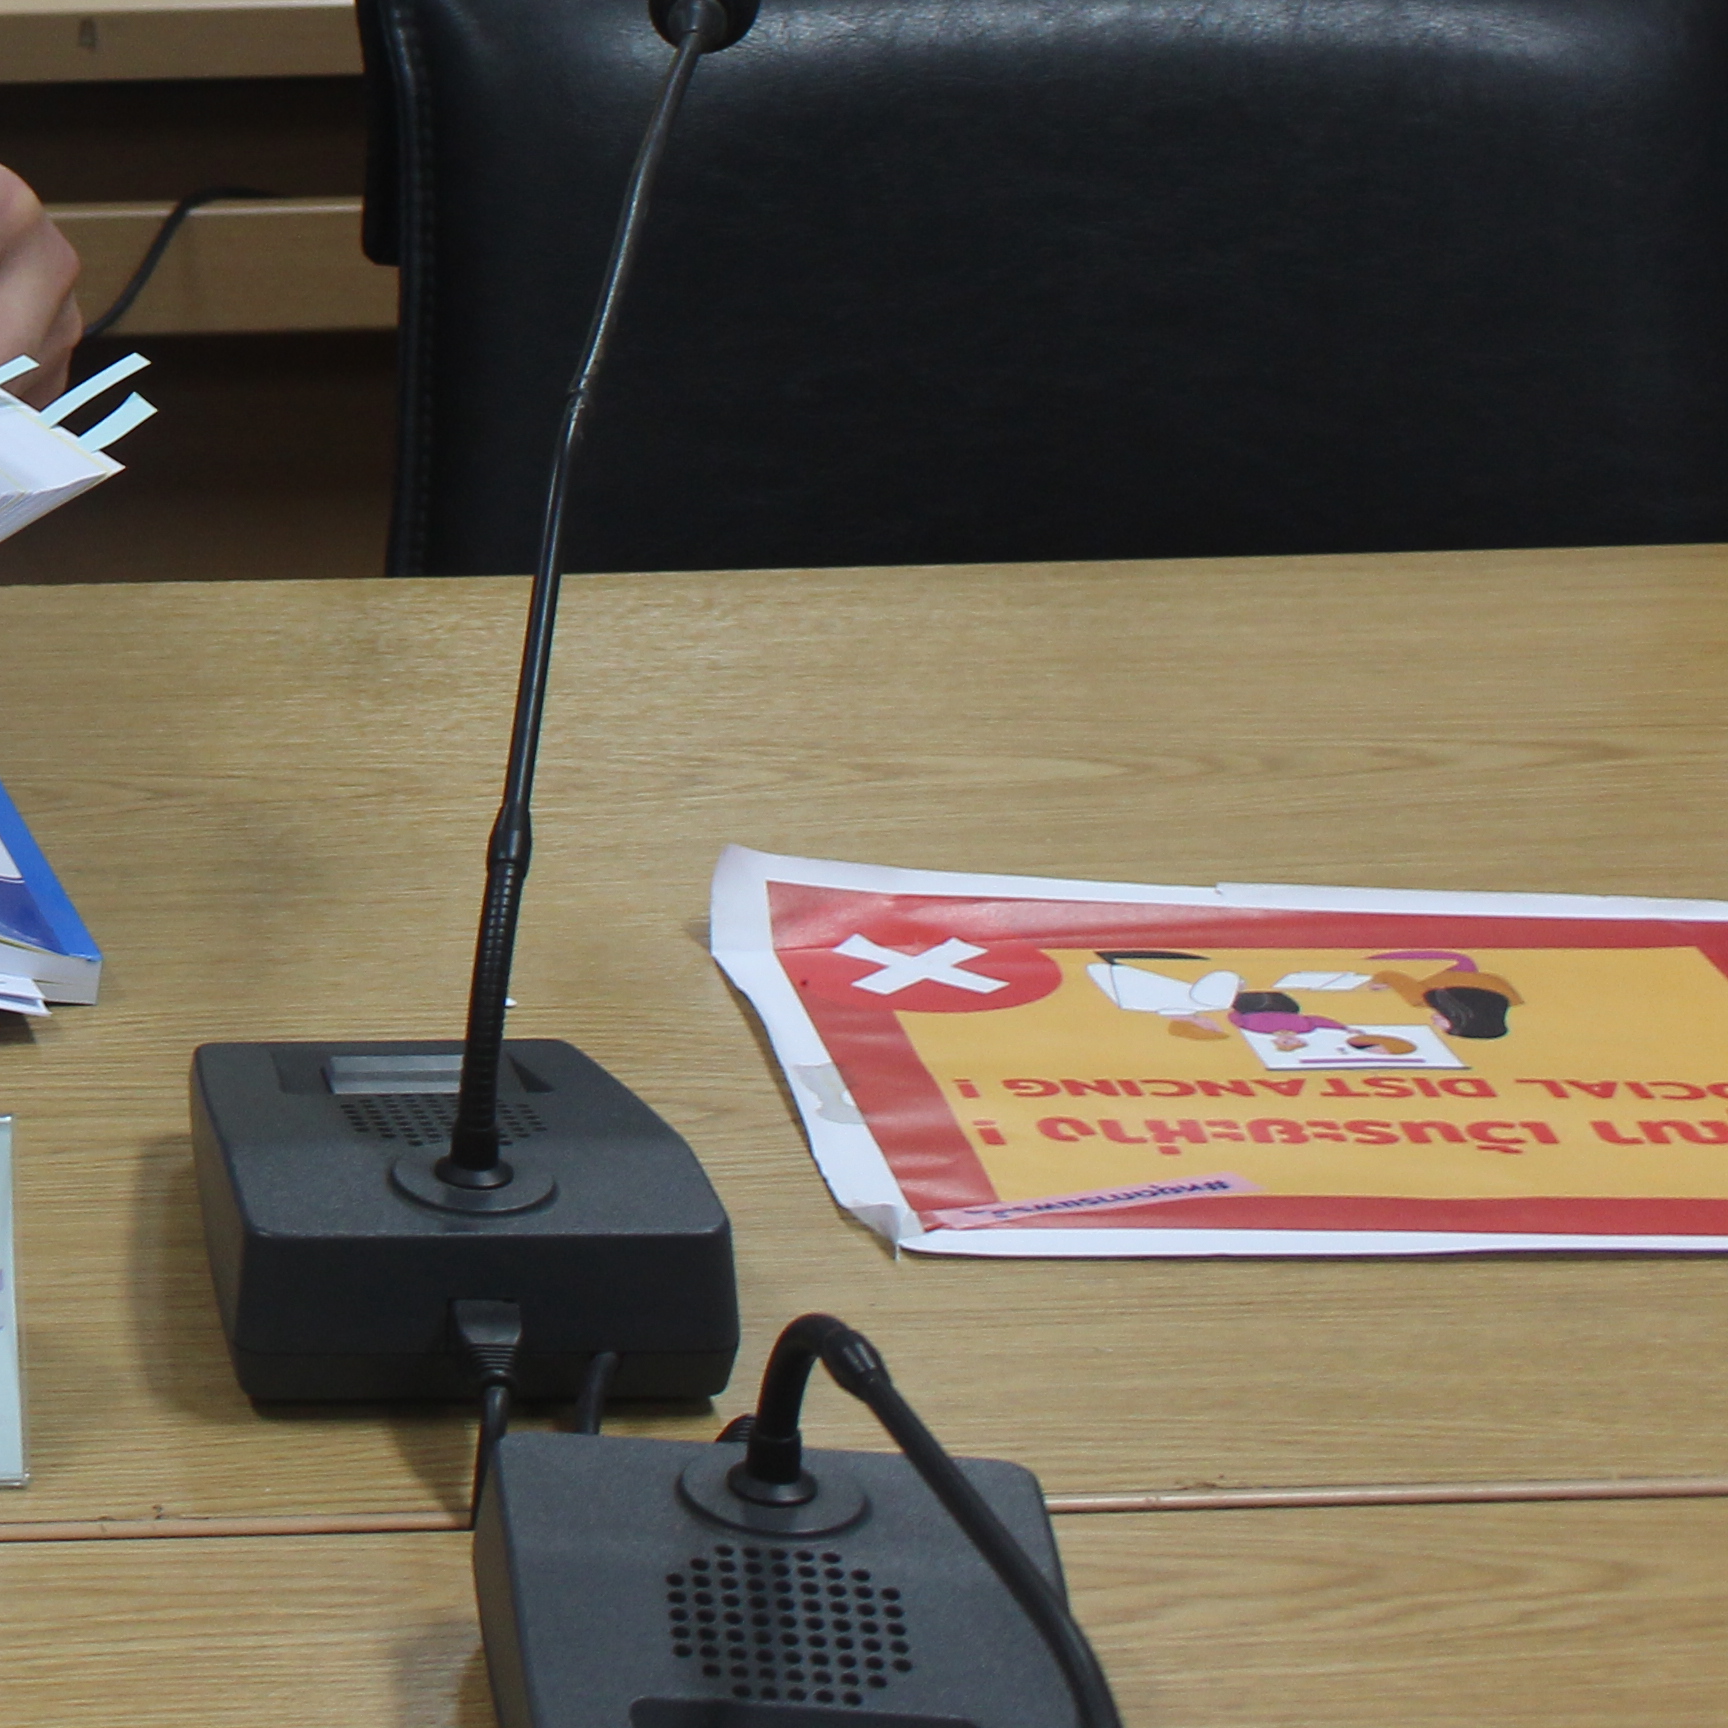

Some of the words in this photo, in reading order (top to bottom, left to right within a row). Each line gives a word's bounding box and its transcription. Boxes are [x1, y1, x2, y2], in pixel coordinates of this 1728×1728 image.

[1000, 1077, 1498, 1099] DISTANCING
[1036, 1116, 1561, 1155] เว้นระยะห่าง
